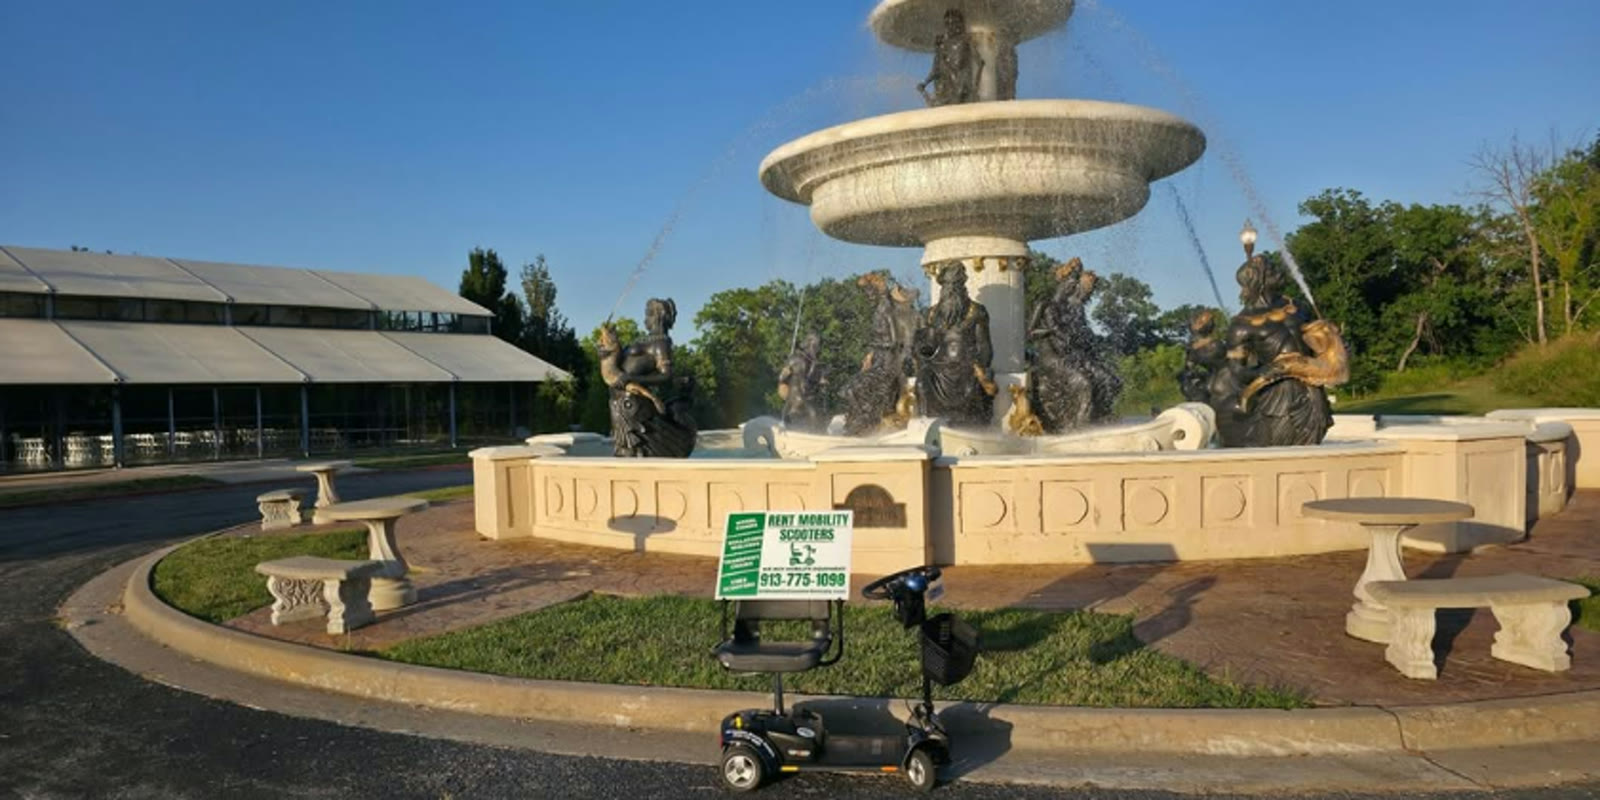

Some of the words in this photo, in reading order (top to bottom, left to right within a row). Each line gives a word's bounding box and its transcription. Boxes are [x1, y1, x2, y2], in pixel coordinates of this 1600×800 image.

[768, 514, 795, 527] RENT
[798, 514, 849, 526] MOBILITY
[779, 529, 835, 541] SCOOTERS
[760, 573, 846, 587] 913-775-1098
